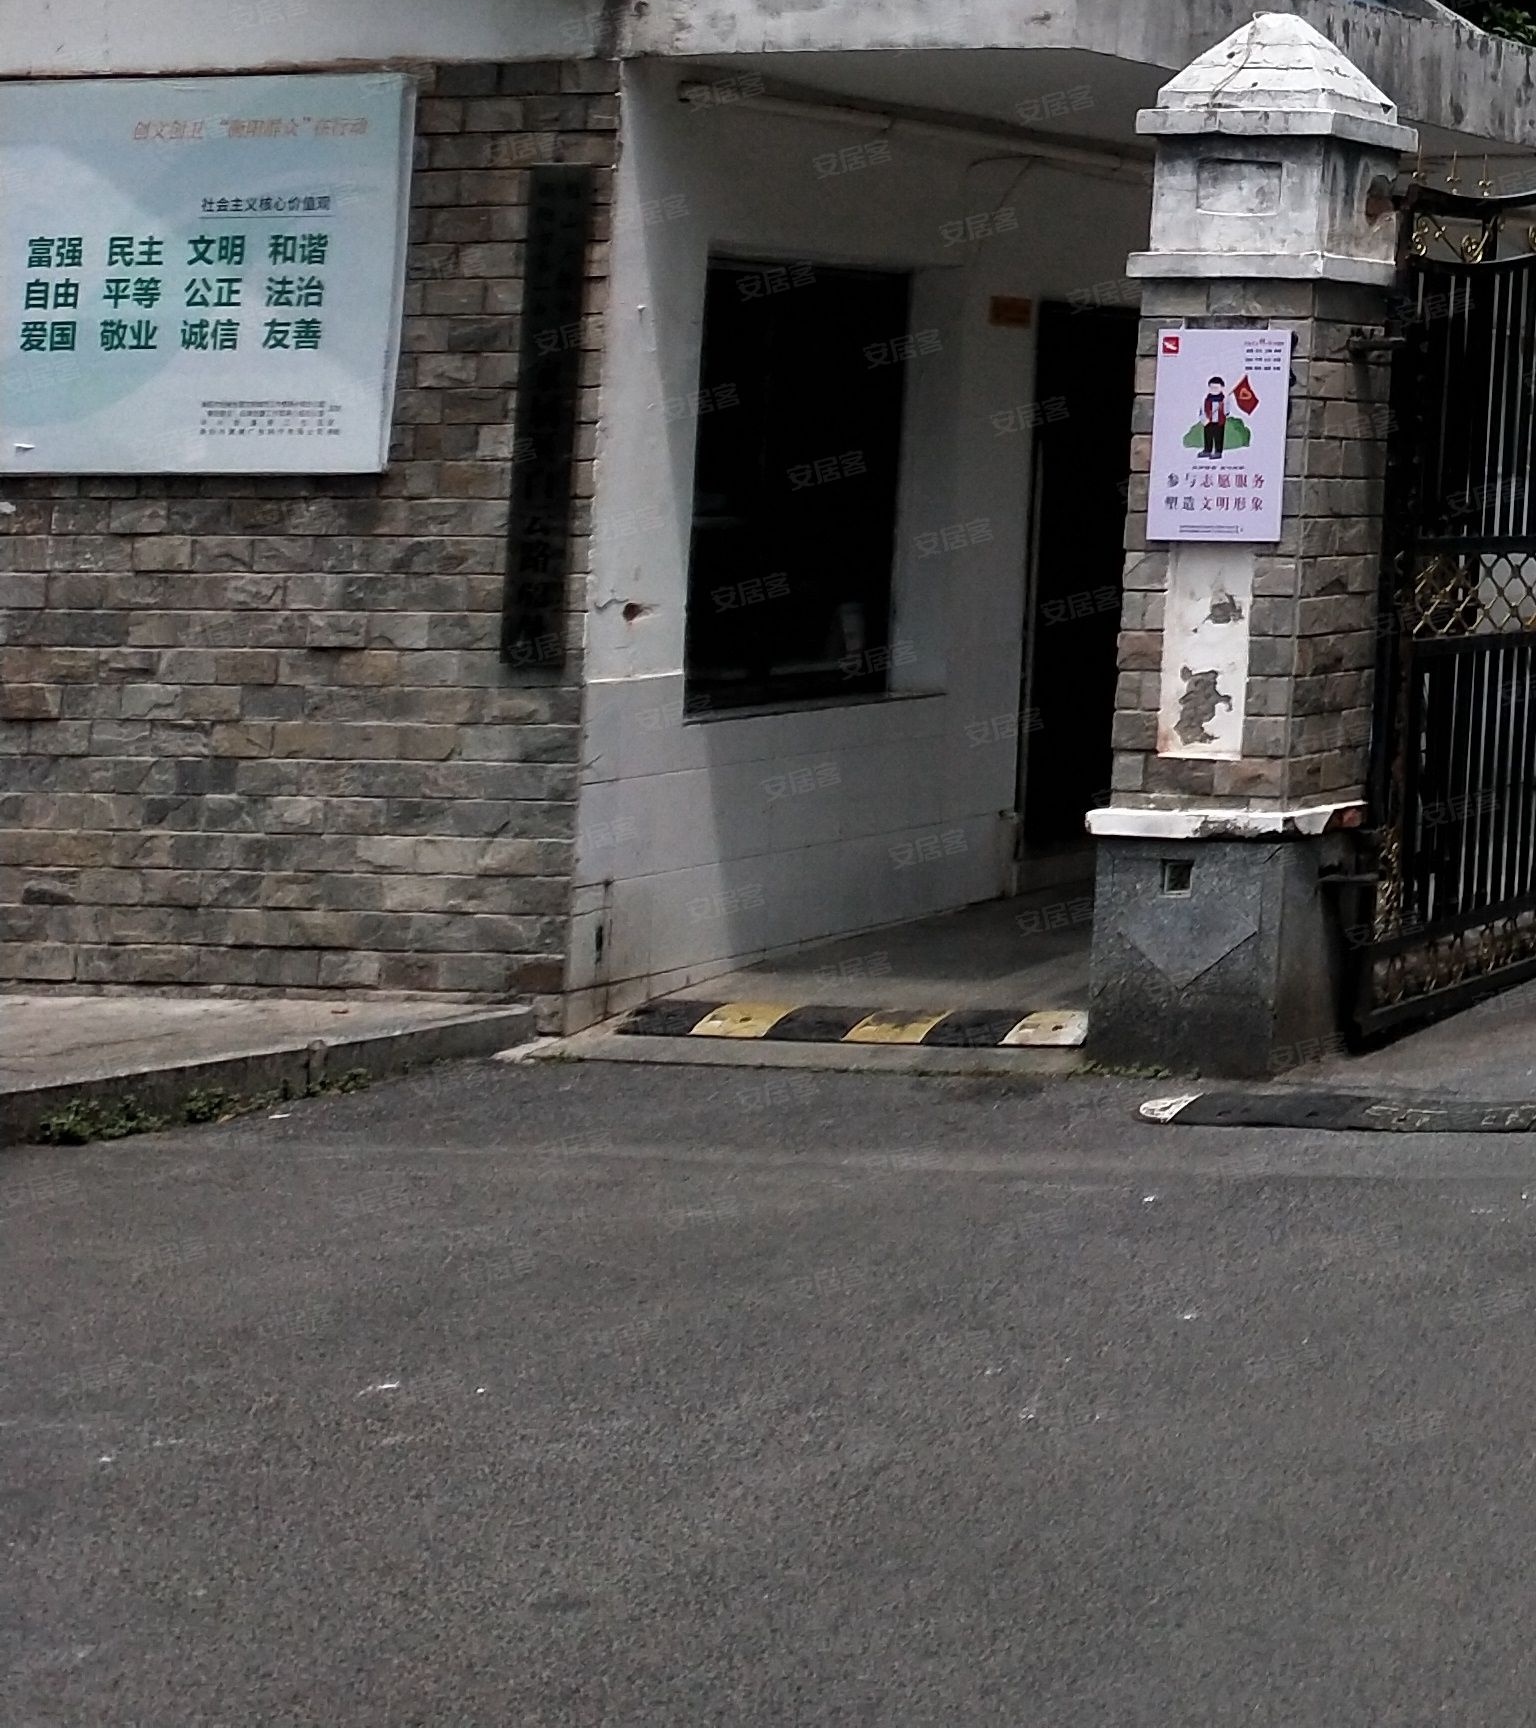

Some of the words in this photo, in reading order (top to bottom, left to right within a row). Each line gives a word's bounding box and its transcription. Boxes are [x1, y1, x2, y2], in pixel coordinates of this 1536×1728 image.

[201, 195, 331, 213] 社会主义核心价值观
[28, 236, 83, 268] 富强
[107, 235, 164, 267] 民主
[188, 234, 246, 266] 文明
[269, 233, 329, 266] 和谐
[24, 279, 79, 310] 自由
[103, 277, 161, 310] 平等
[184, 276, 243, 309] 公正
[265, 276, 325, 309] 法治
[20, 321, 76, 353] 爱国
[100, 320, 158, 352] 敬业
[181, 319, 240, 351] 诚信
[262, 319, 322, 351] 友善
[1167, 472, 1265, 488] 参与志愿服务
[1164, 496, 1264, 512] 塑造文明形象
